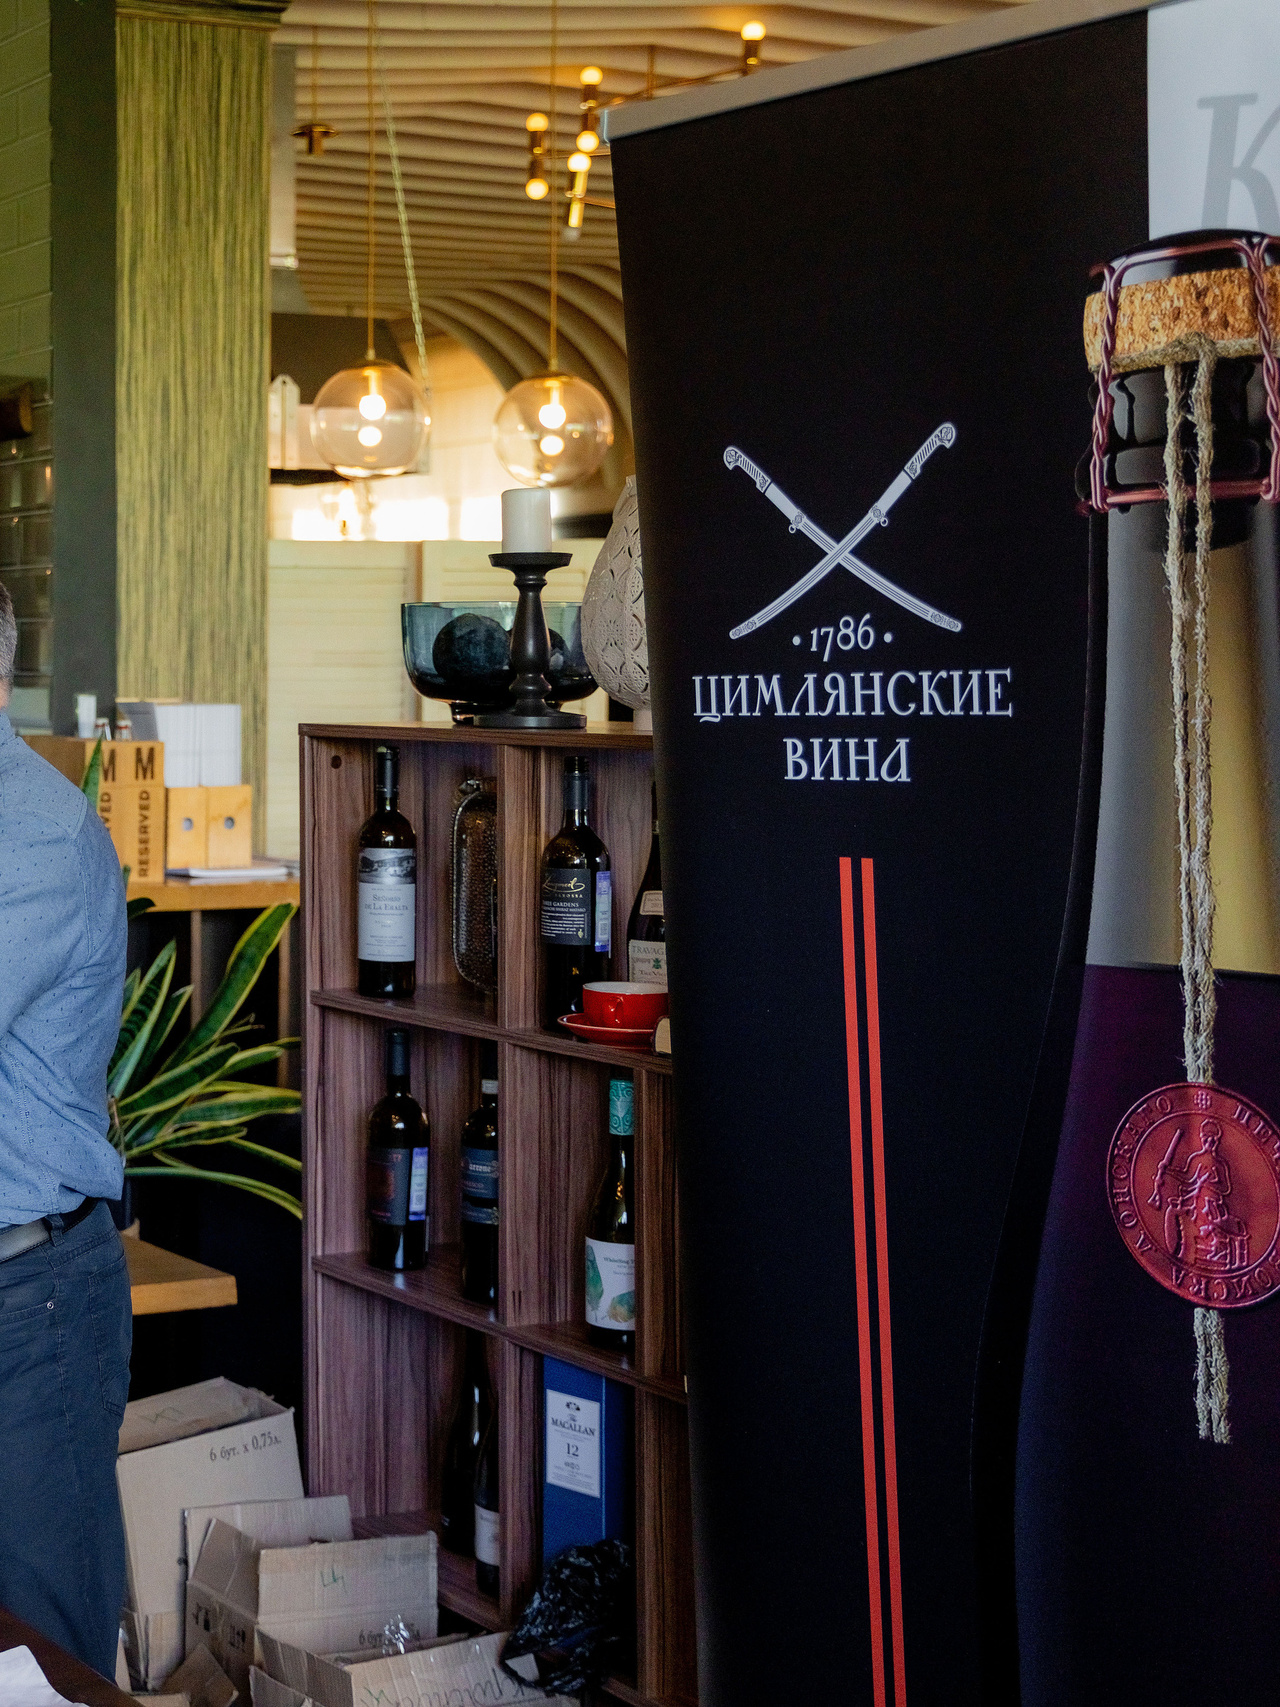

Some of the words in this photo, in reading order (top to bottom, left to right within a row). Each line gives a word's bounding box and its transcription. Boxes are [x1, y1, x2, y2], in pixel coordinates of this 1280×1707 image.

[809, 613, 875, 662] 1786
[692, 667, 1014, 723] ЦИМЛЯНСКИЕ
[783, 738, 912, 782] ВИНА
[138, 789, 151, 877] RESERVED
[551, 1417, 596, 1436] MACALLAN
[209, 1447, 217, 1461] 6
[566, 1442, 579, 1457] 12
